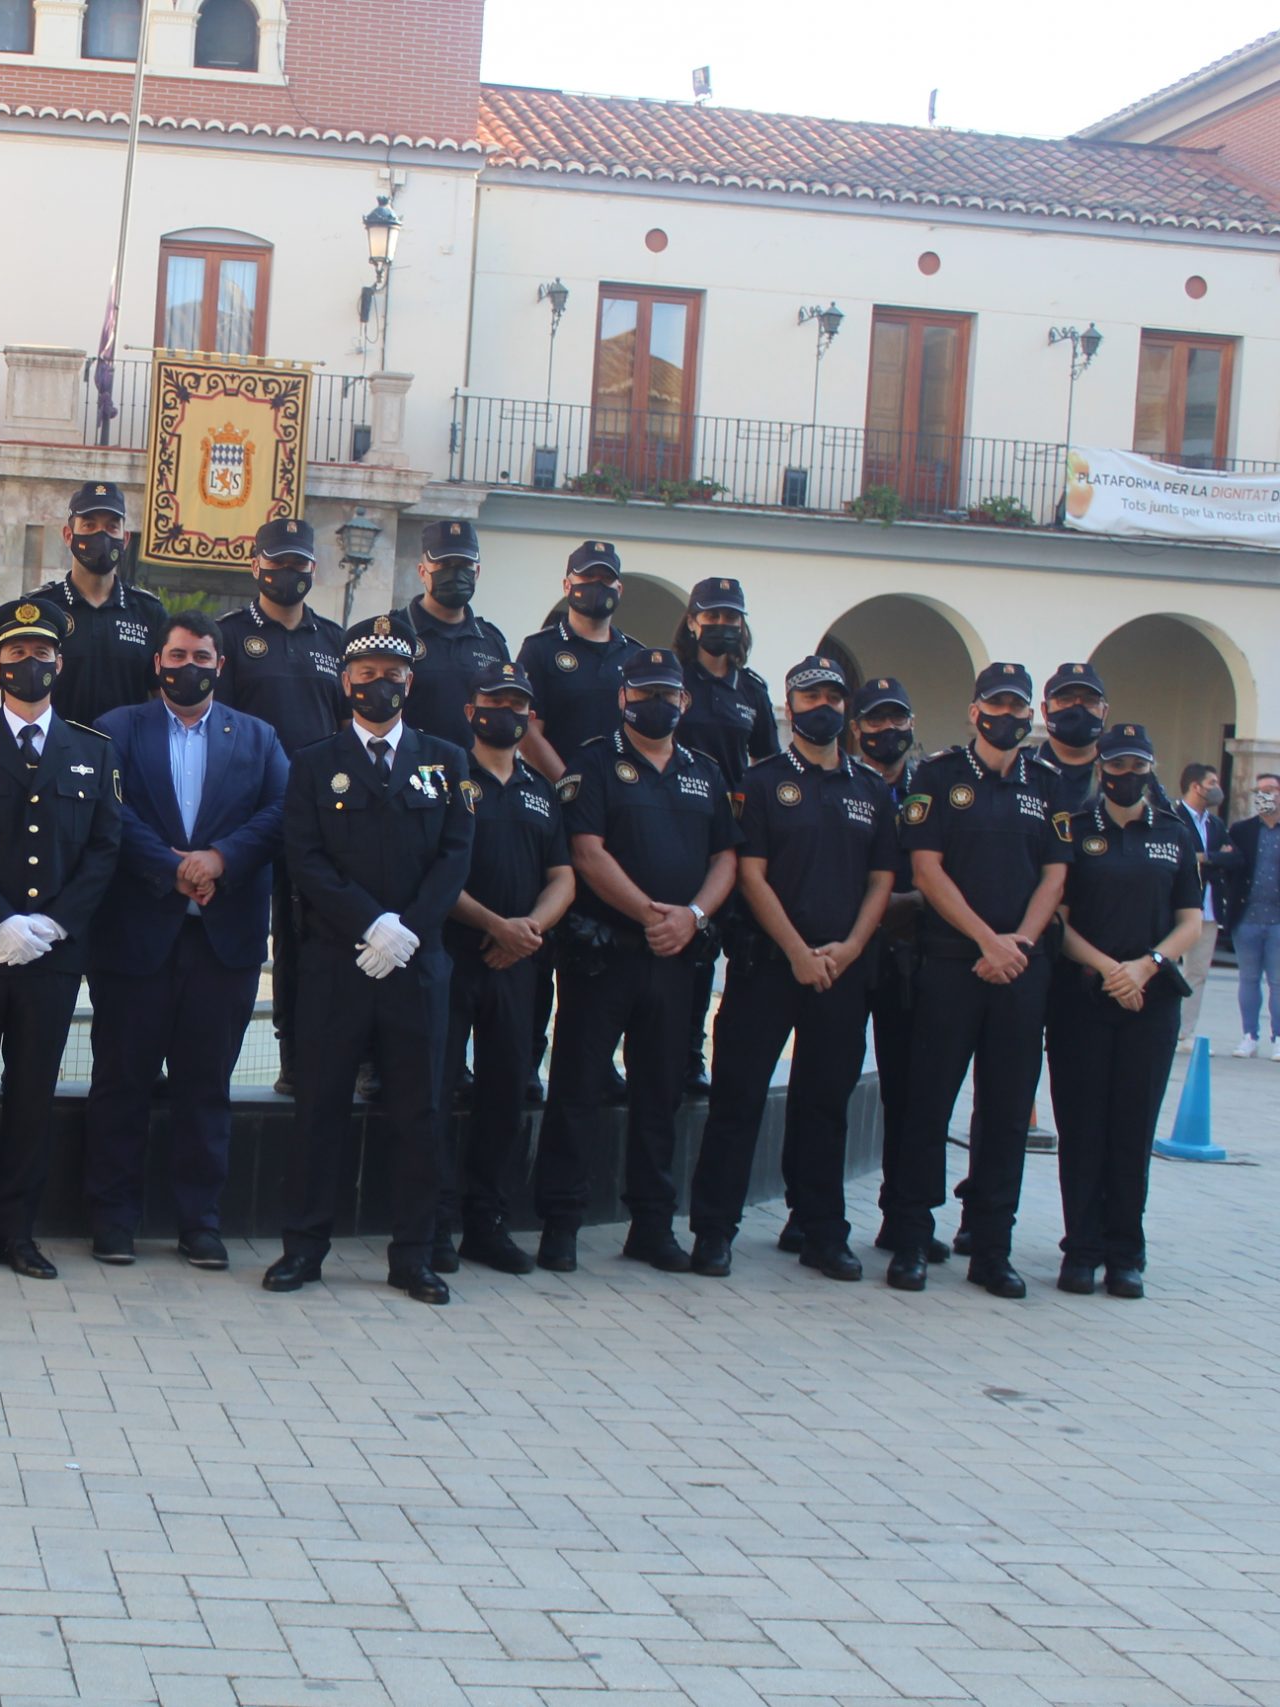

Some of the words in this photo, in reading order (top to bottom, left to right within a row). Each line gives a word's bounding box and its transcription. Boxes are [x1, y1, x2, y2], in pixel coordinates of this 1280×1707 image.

[232, 473, 241, 489] S
[1078, 472, 1161, 491] PLATAFORMA
[1164, 482, 1189, 495] PER
[1191, 485, 1207, 496] LA
[1211, 486, 1270, 501] DIGNITAT
[1121, 497, 1147, 511] Tots
[1148, 500, 1179, 515] junts
[1182, 506, 1201, 517] per
[1203, 506, 1214, 518] la
[1217, 510, 1255, 522] nostra
[115, 620, 149, 633] POLICIA
[120, 627, 146, 639] LOCAL
[119, 633, 146, 646] Nules
[309, 651, 341, 664] POLICIA
[314, 657, 338, 670] LOCAL
[677, 773, 710, 788] POLICIA
[520, 790, 550, 808] POLICIA
[842, 798, 875, 812] POLICIA
[847, 804, 873, 817] LOCAL
[1144, 842, 1180, 852] POLICIA
